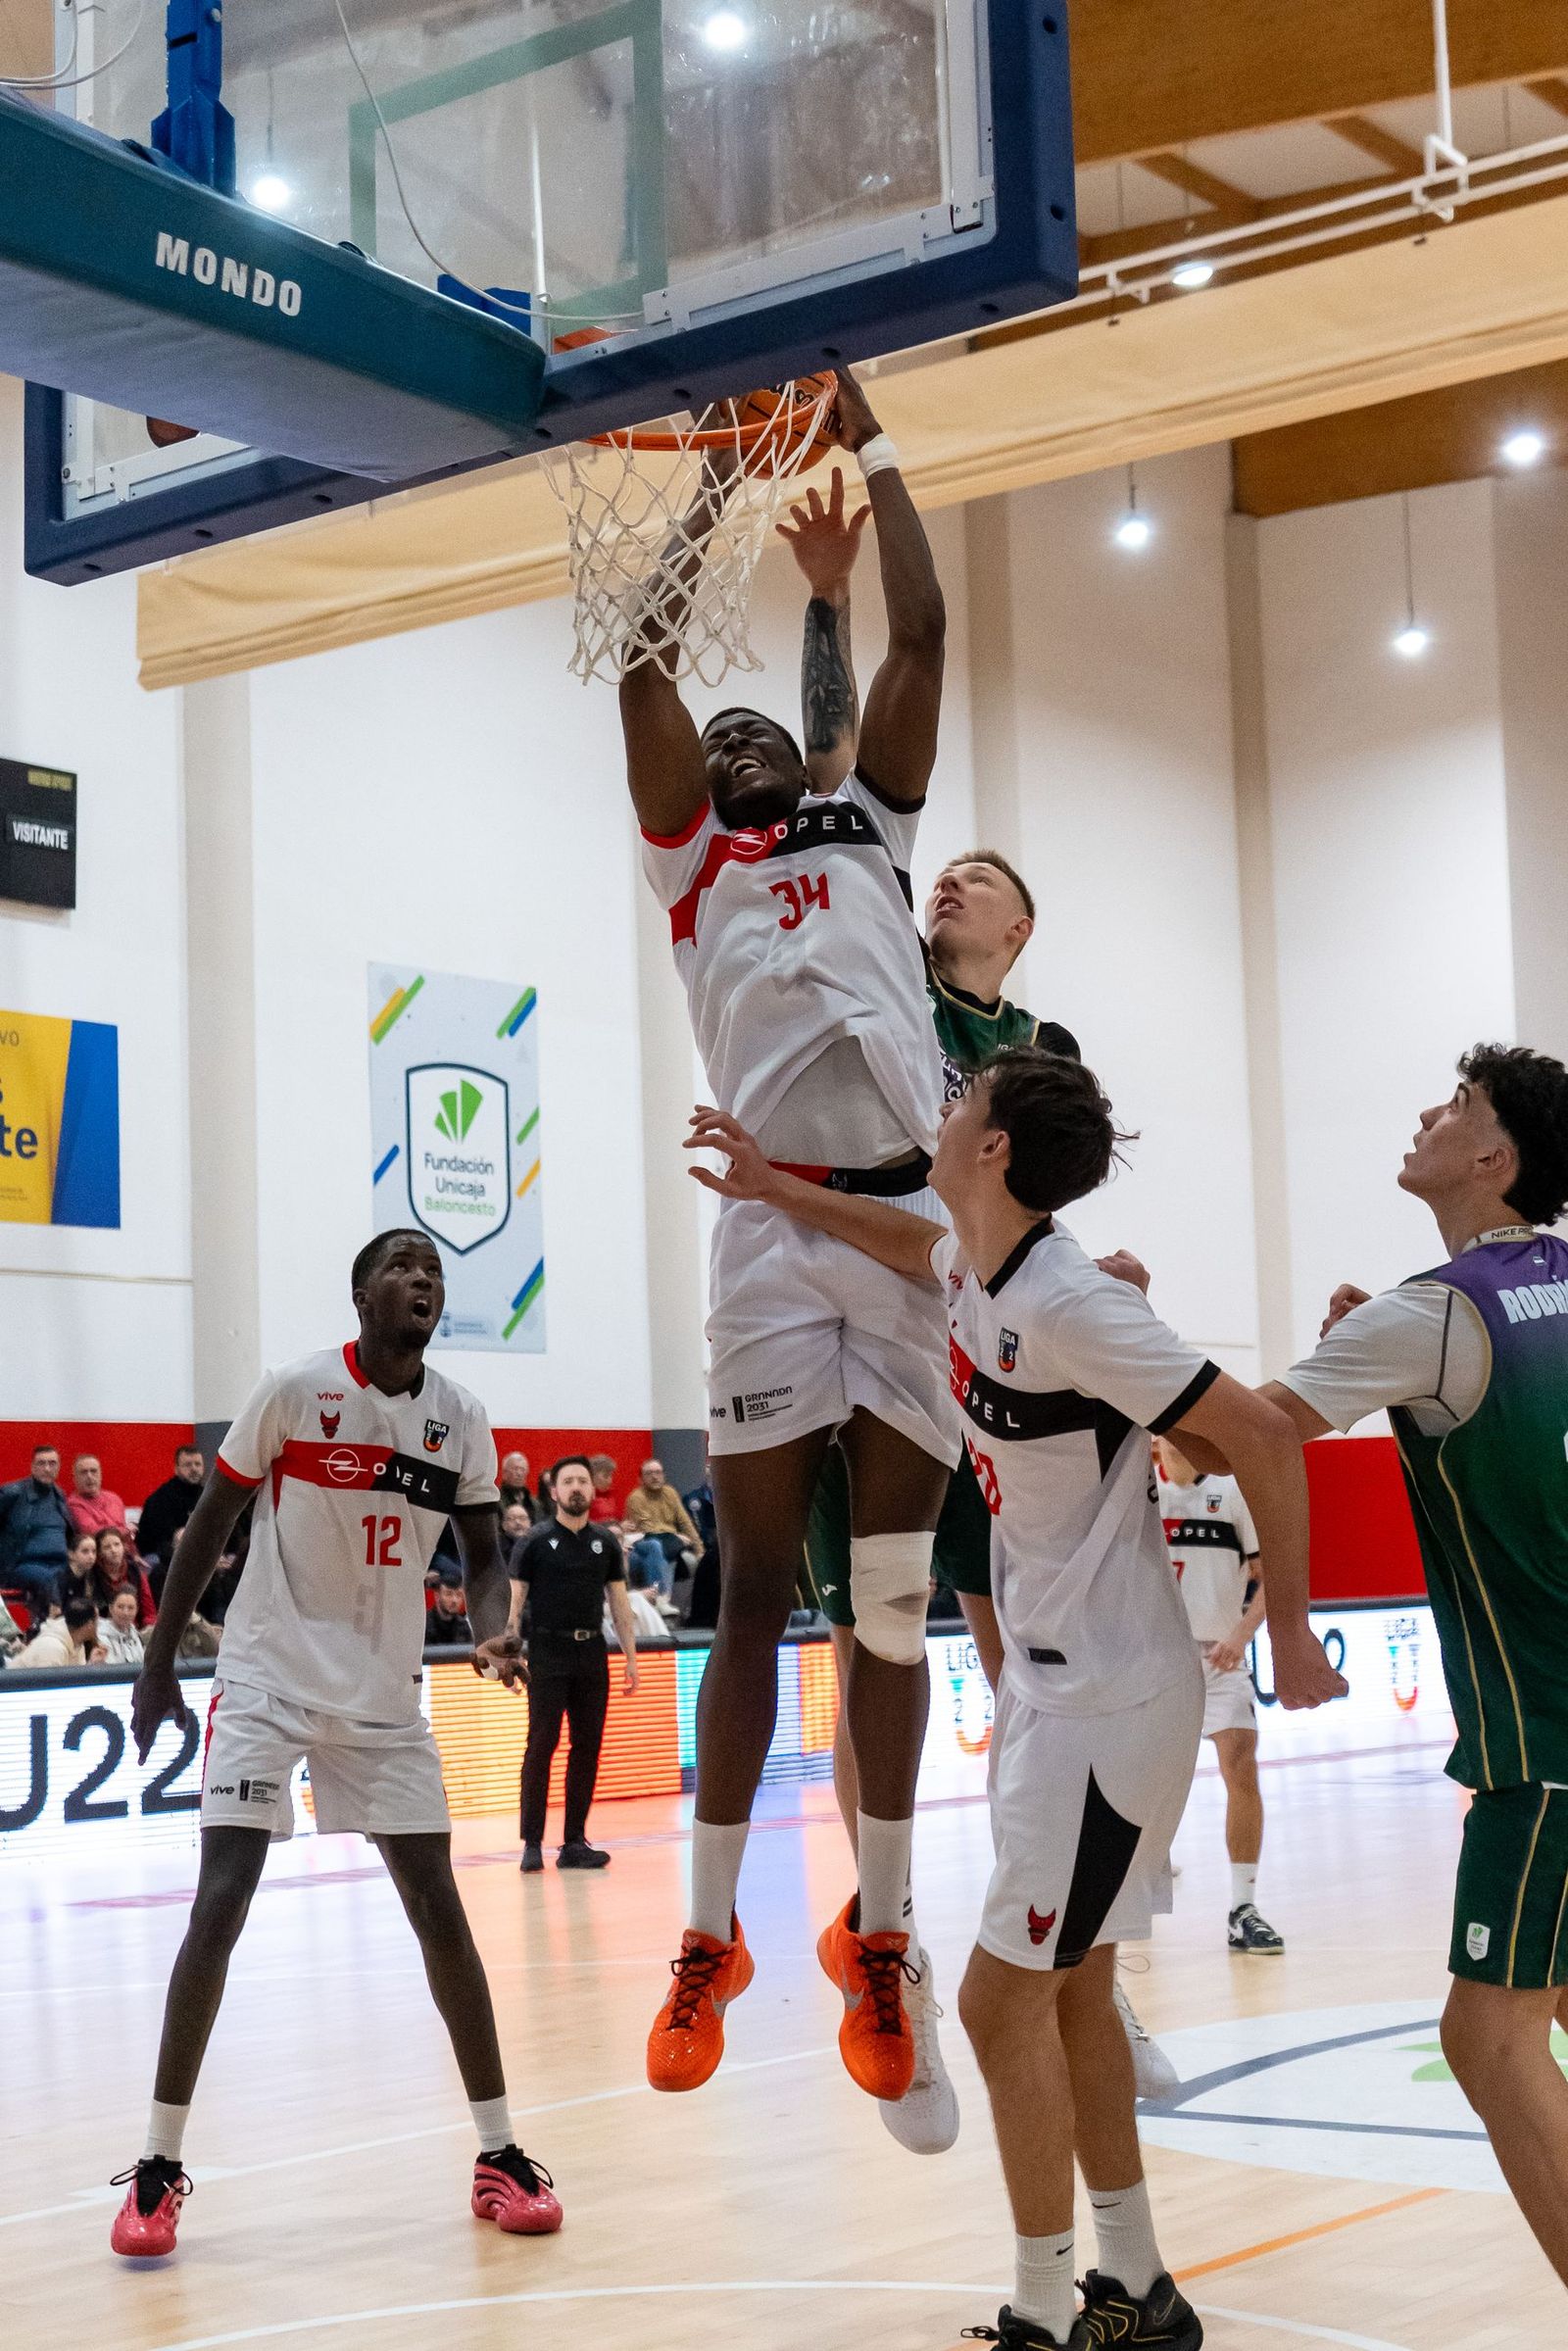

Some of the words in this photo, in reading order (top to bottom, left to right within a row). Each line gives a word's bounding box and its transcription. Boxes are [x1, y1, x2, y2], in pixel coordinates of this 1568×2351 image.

[155, 231, 302, 317] MONDO
[13, 821, 68, 850] VISITANTE
[774, 815, 863, 840] OPEL
[768, 872, 831, 930] 34
[424, 1152, 494, 1175] Fundación
[435, 1176, 486, 1200] Unicaja
[424, 1196, 496, 1216] Baloncesto
[1491, 1227, 1517, 1240] NIKE
[1001, 1332, 1016, 1346] LIGA
[318, 1392, 344, 1401] vive
[745, 1386, 793, 1402] GRANADA
[961, 1380, 1020, 1428] OPEL
[747, 1401, 769, 1412] 2031
[427, 1421, 447, 1433] LIGA
[362, 1515, 402, 1566] 12
[1171, 1529, 1219, 1539] OPEL
[210, 1785, 235, 1795] vive
